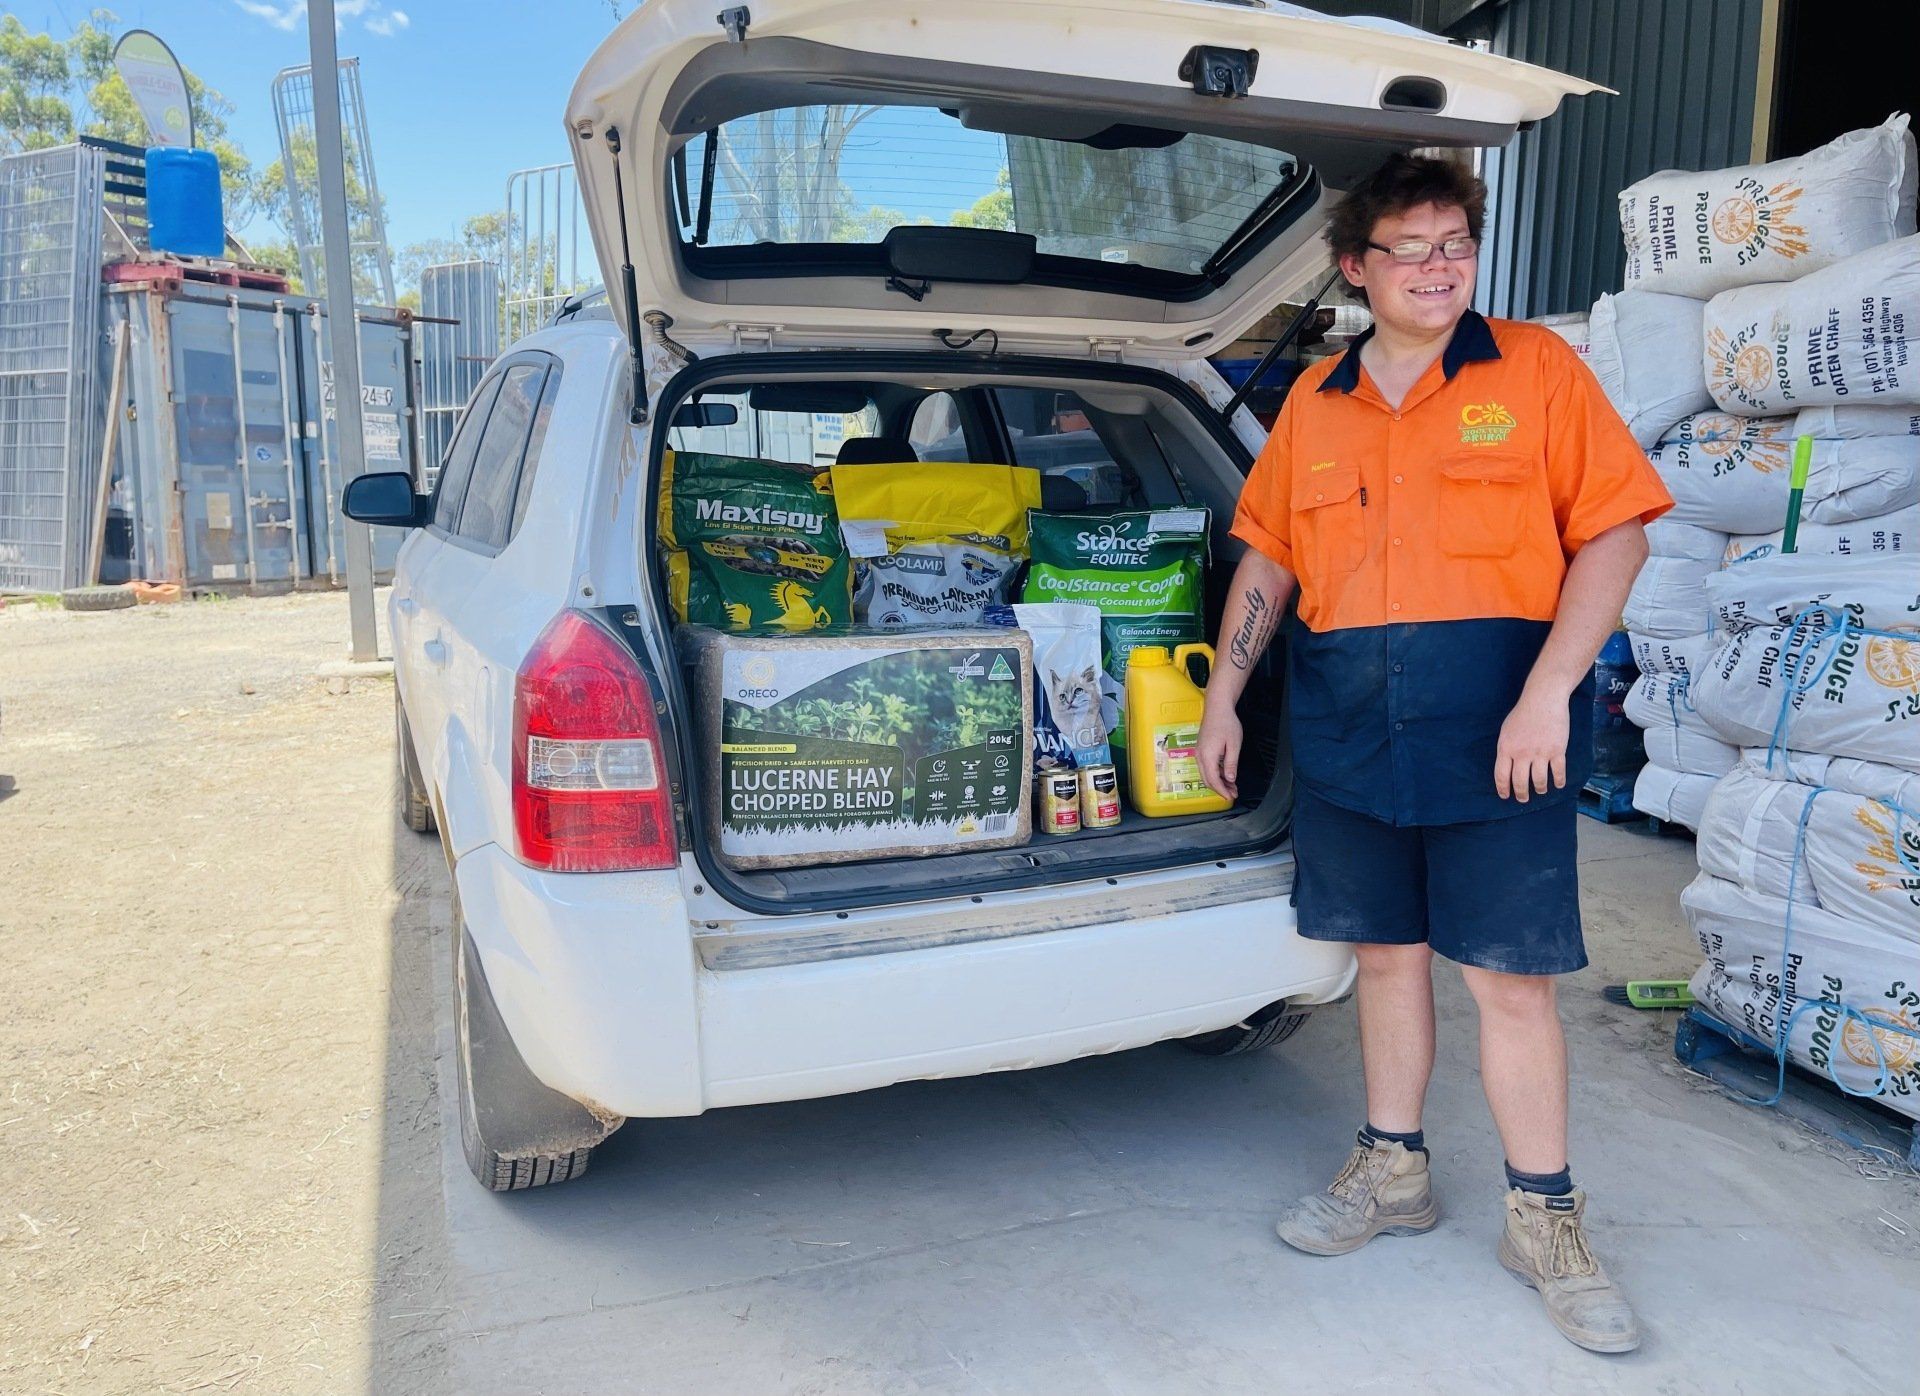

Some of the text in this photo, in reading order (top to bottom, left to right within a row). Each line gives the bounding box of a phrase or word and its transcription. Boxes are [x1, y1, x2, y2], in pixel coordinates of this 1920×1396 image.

[1662, 205, 1678, 261] PRIME
[1695, 191, 1712, 264] PRODUCE
[1735, 177, 1771, 266] SPRENGER'S
[1648, 195, 1663, 275] OATEN CHAFF
[1862, 296, 1875, 324] 4356
[1879, 296, 1892, 334] Highway
[1892, 312, 1905, 335] 4306
[1776, 323, 1796, 400] PRODUCE
[1807, 325, 1828, 387] PRIME
[1826, 307, 1849, 396] OATEN CHAFF
[1885, 366, 1899, 389] 2075
[695, 498, 823, 535] Maxisoy
[1077, 523, 1149, 552] Stance
[1090, 553, 1149, 566] EQUITEC
[882, 583, 939, 606] PREMIUM
[1138, 572, 1185, 594] Copra
[901, 599, 967, 615] SORGHUM
[1099, 597, 1144, 606] Coconut
[1145, 594, 1169, 607] Meal
[1121, 628, 1180, 637] Balanced Energy
[1230, 587, 1266, 670] Family
[738, 688, 779, 699] ORECO
[989, 734, 1012, 747] 20kg
[731, 766, 894, 791] LUCERNE HAY
[730, 790, 895, 812] CHOPPED BLEND
